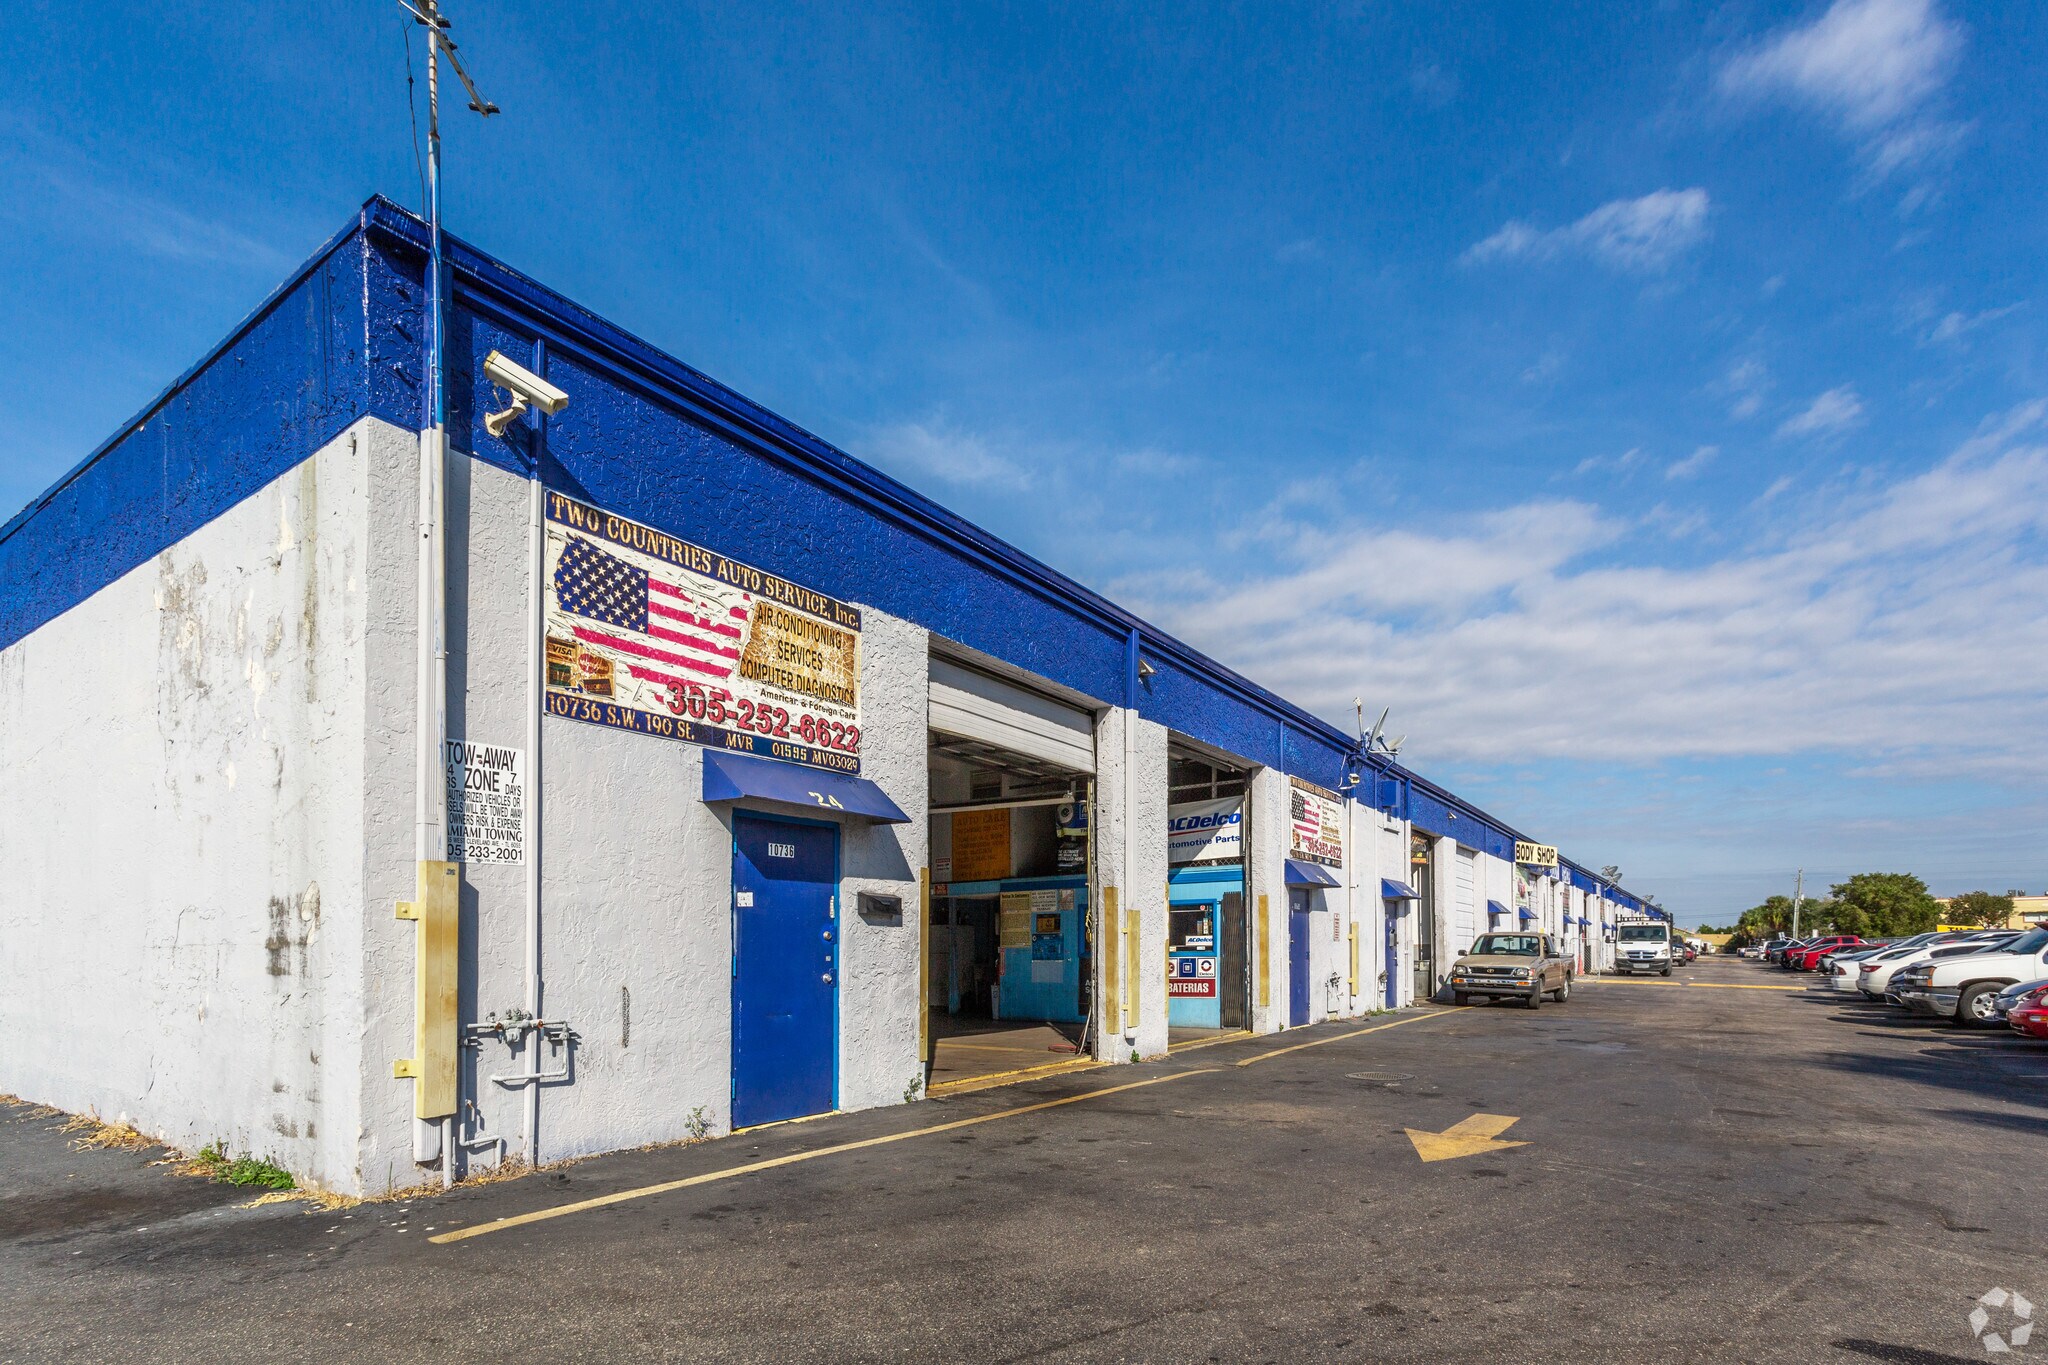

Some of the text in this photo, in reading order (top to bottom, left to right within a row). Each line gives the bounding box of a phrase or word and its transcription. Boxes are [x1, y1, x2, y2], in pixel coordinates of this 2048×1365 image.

[551, 494, 859, 628] TWO COUNTRIES AUTO SERVICE, Inc.
[757, 605, 842, 650] AIR CONDITIONING
[552, 645, 573, 656] VISA
[777, 640, 823, 672] SERVICES
[740, 658, 794, 689] COMPUTER
[796, 674, 855, 706] DIAGNOSTICS
[548, 694, 696, 741] 10736 S.W. 190 St.
[666, 680, 861, 754] 305-252-6622
[839, 708, 857, 721] Cars
[725, 732, 754, 751] MVR
[446, 741, 517, 772] TOW-AWAY
[772, 742, 859, 771] 01595 MV03029
[464, 768, 500, 793] ZONE
[510, 773, 517, 784] 7
[505, 784, 522, 797] DAYS
[485, 794, 511, 807] VEHICLES
[513, 797, 521, 807] OR
[465, 803, 479, 815] WILL
[480, 805, 488, 816] BE
[490, 806, 509, 818] TOWED
[511, 809, 524, 819] AWAY
[449, 814, 474, 826] OWNERS
[476, 815, 489, 827] RISK
[497, 818, 521, 830] EXPENSE
[485, 828, 522, 843] TOWING
[1168, 835, 1240, 849] utomotive Parts
[769, 844, 793, 857] 10736
[1516, 844, 1555, 864] BODY SHOP
[1169, 982, 1209, 993] BATERIAS
